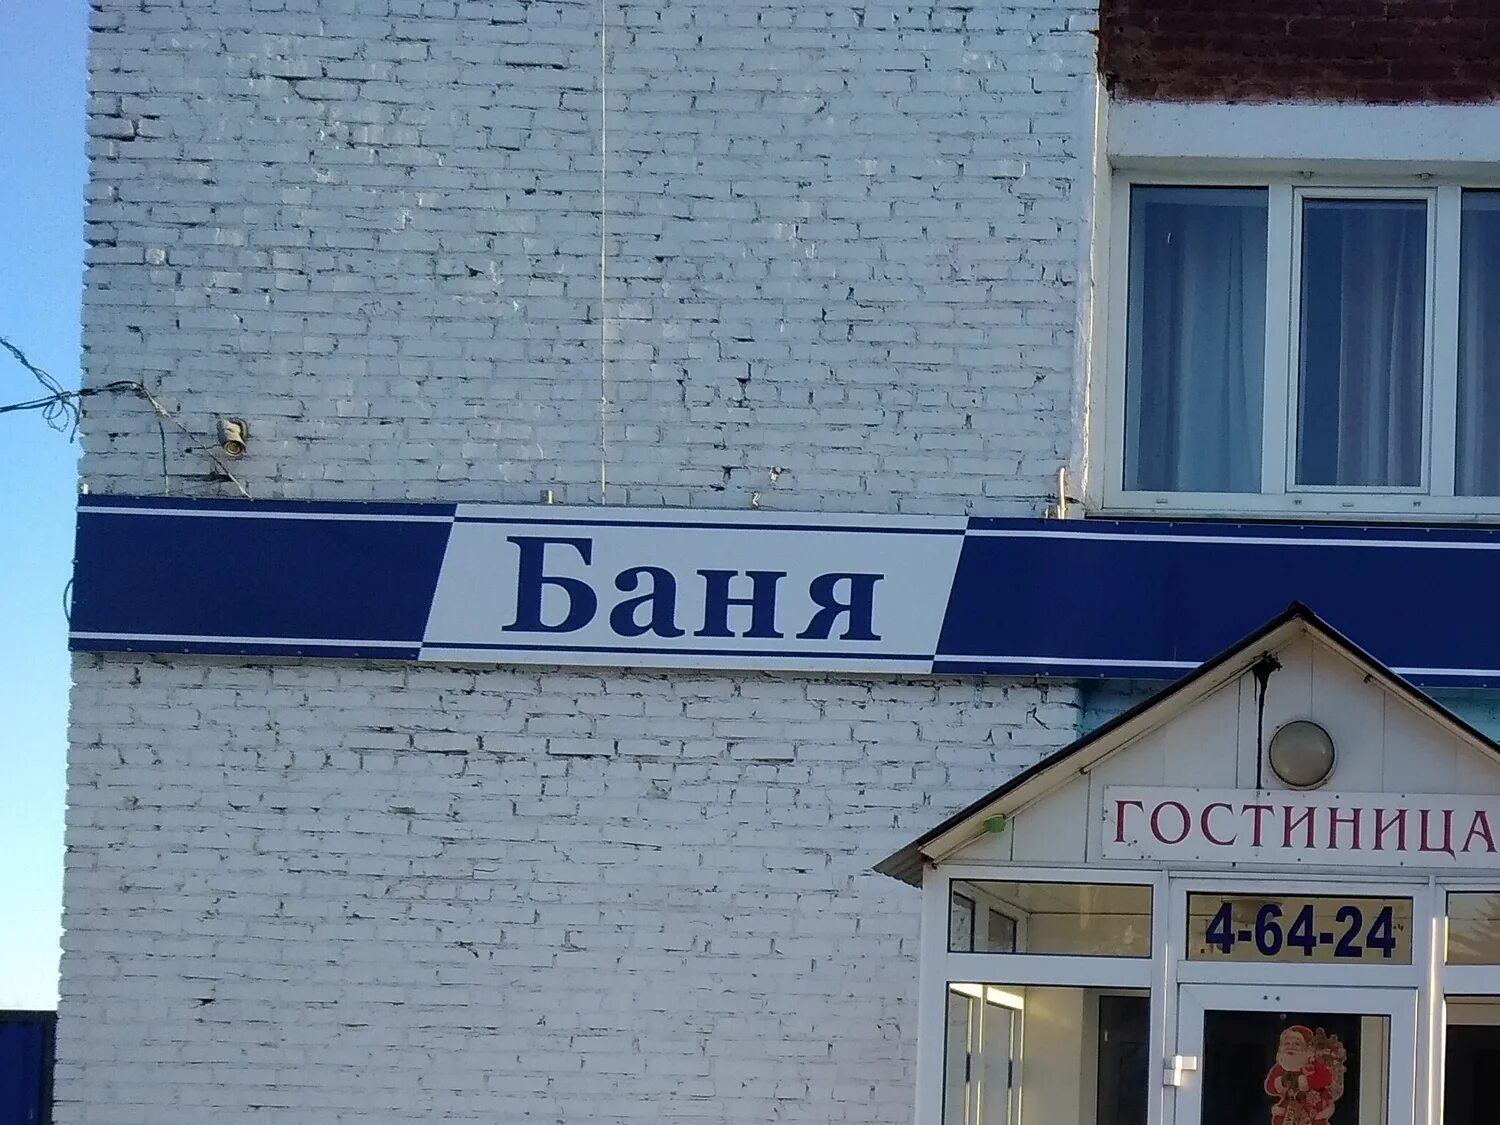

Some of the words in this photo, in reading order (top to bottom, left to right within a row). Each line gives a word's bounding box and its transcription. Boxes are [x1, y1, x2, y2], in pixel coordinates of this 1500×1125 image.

[501, 535, 885, 641] Баня
[1113, 800, 1498, 861] ГОСТИНИЦА
[1206, 902, 1397, 958] 4-64-24
